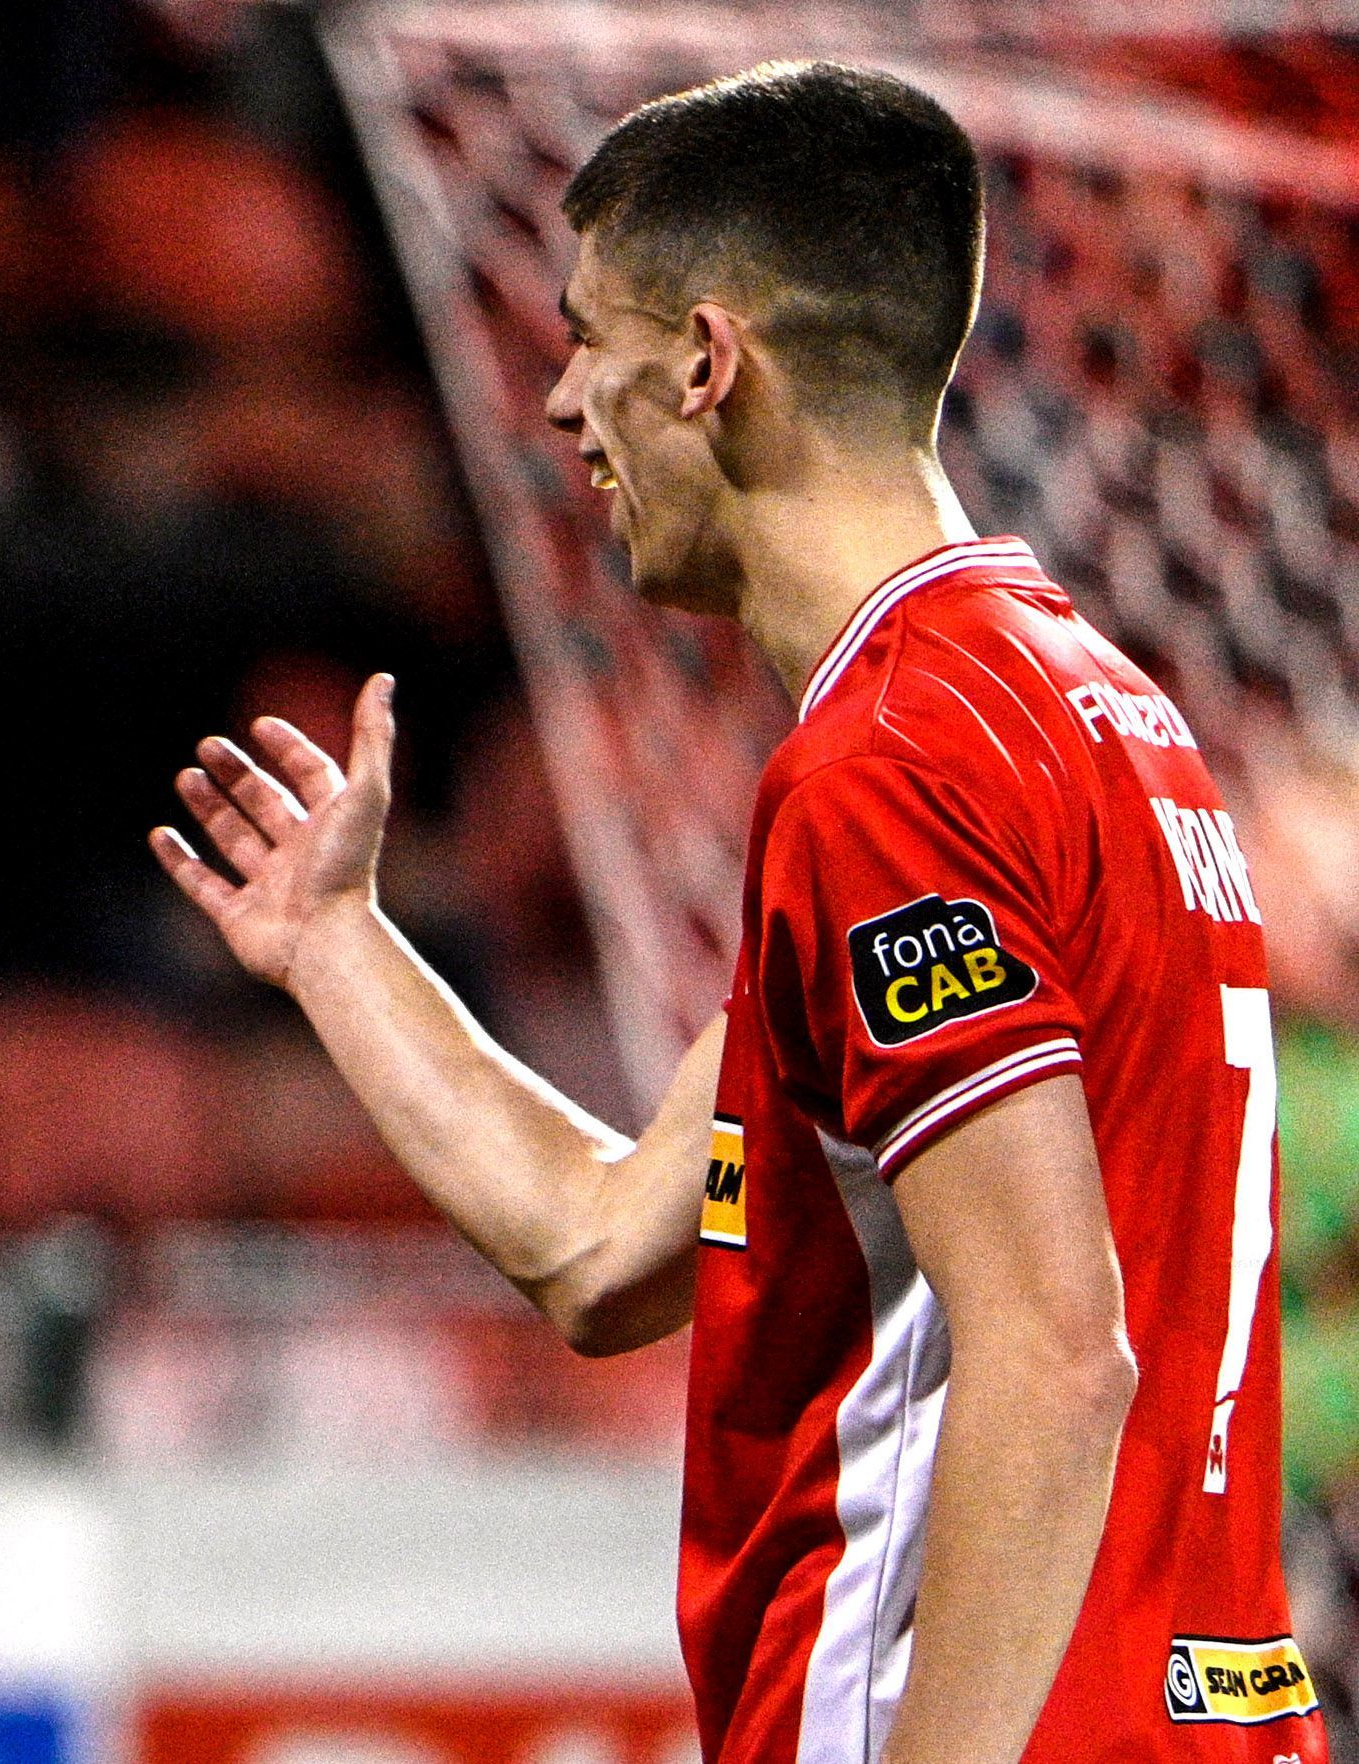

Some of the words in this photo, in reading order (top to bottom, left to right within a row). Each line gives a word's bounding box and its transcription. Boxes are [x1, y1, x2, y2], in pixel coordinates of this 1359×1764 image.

[872, 915, 985, 977] fona
[885, 947, 1007, 1023] CAB
[1202, 983, 1277, 1494] 7
[1205, 1666, 1248, 1698] SEAN
